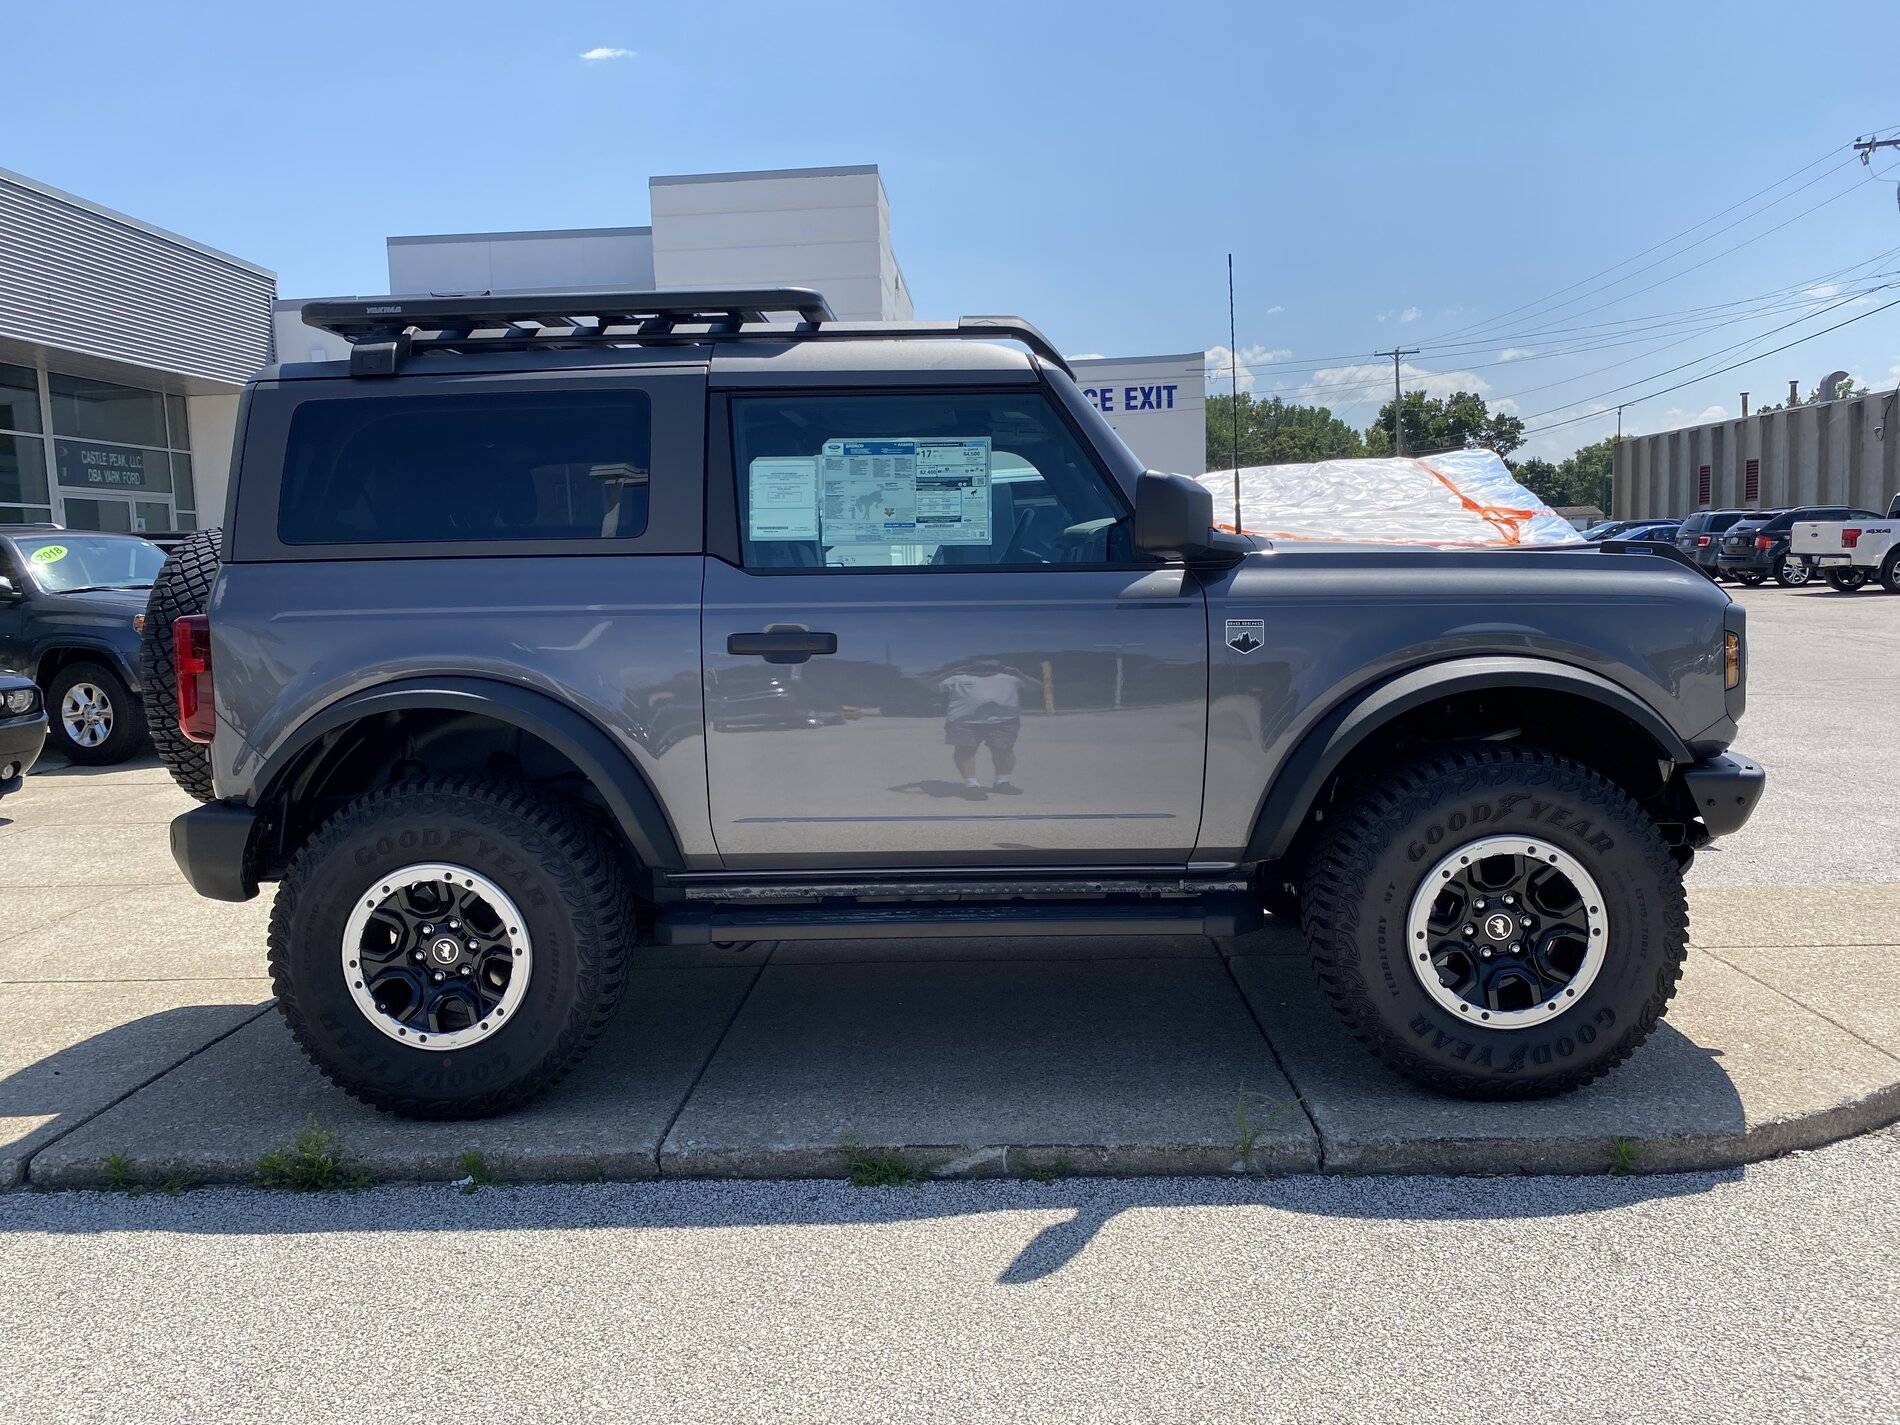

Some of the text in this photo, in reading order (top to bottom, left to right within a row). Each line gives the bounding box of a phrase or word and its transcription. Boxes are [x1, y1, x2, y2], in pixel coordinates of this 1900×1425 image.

[1124, 384, 1178, 411] EXIT
[81, 450, 108, 466] CASTLE
[920, 449, 932, 458] 17
[87, 468, 103, 482] DBA
[122, 471, 141, 485] FORD
[36, 546, 64, 561] 2018
